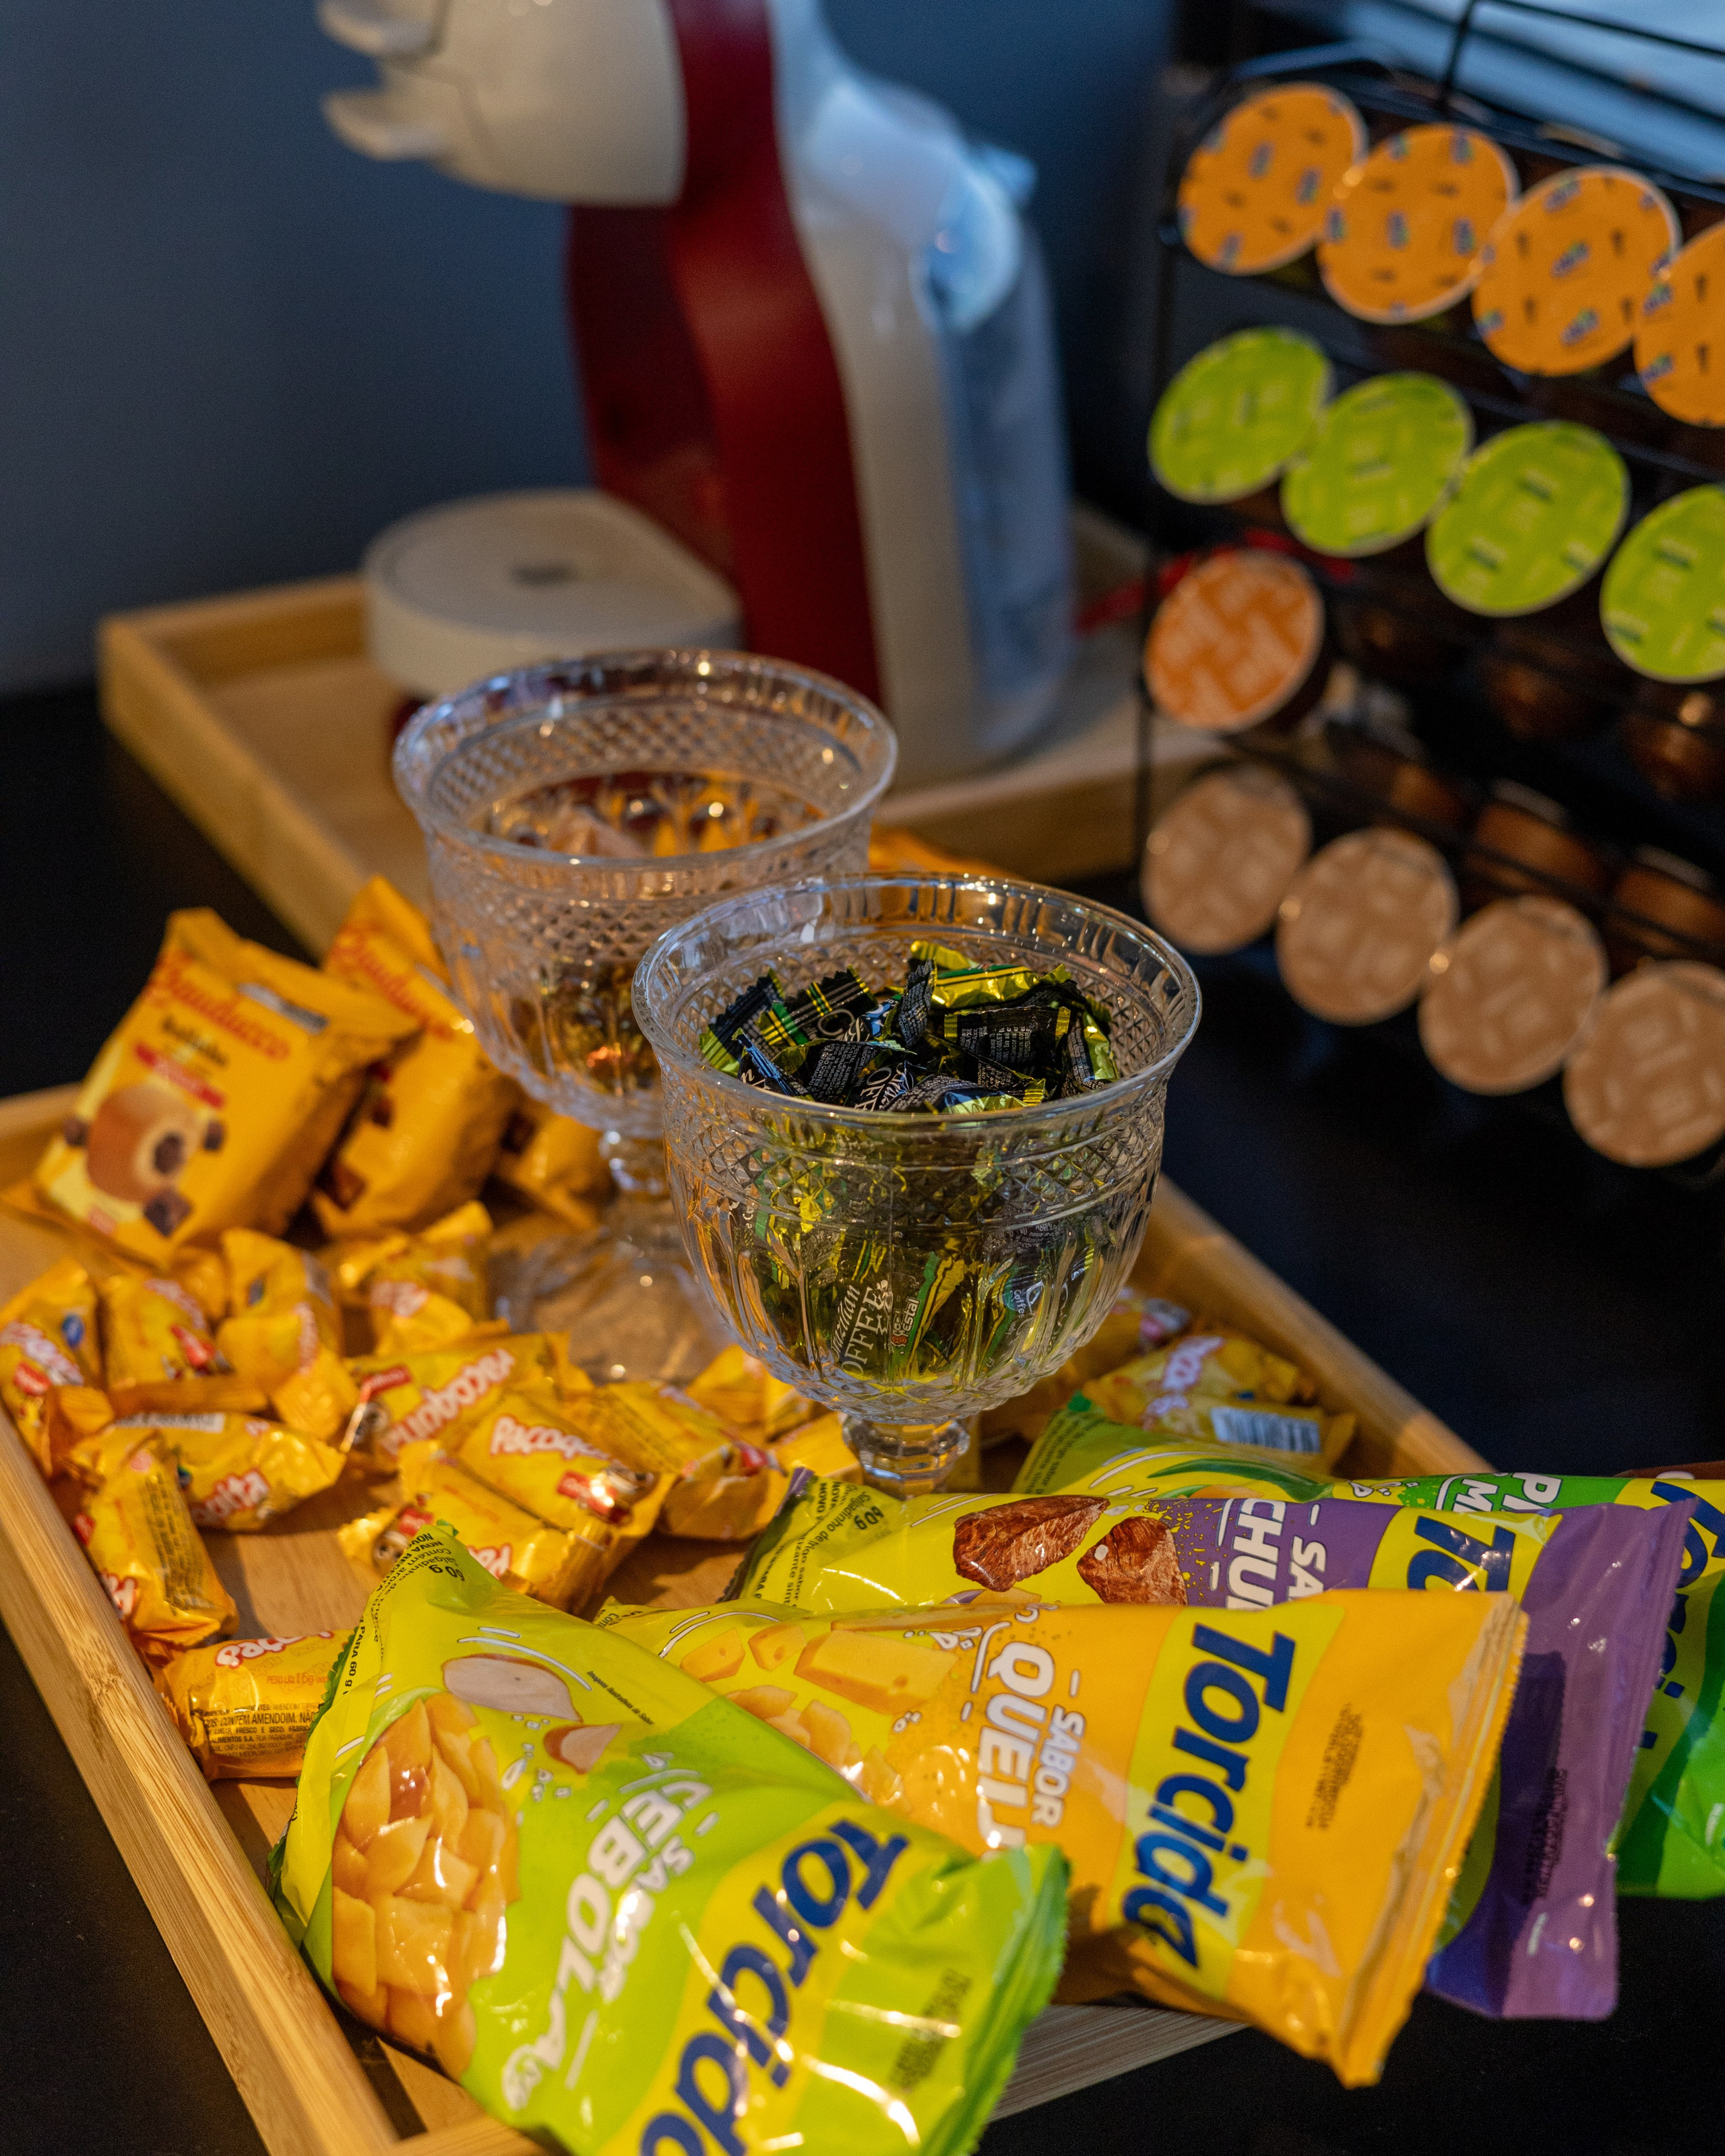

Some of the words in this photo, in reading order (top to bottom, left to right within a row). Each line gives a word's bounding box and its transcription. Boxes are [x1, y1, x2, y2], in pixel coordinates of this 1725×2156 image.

[1013, 1288, 1026, 1319] Coffee
[827, 1490, 872, 1533] Salgadinho
[411, 1540, 443, 1553] NOVA
[794, 1564, 808, 1602] sabor
[351, 1626, 366, 1659] PARA
[344, 1678, 353, 1688] g
[348, 1661, 358, 1677] 60
[211, 1735, 243, 1744] ALIMENTOS
[236, 1726, 257, 1735] FRESCO
[975, 1640, 1057, 1860] QUEIJ
[1031, 1703, 1086, 1828] SABOR
[1121, 1622, 1296, 1969] Torcida
[535, 1779, 713, 2071] CEBOLA
[598, 1835, 696, 2004] SABOR
